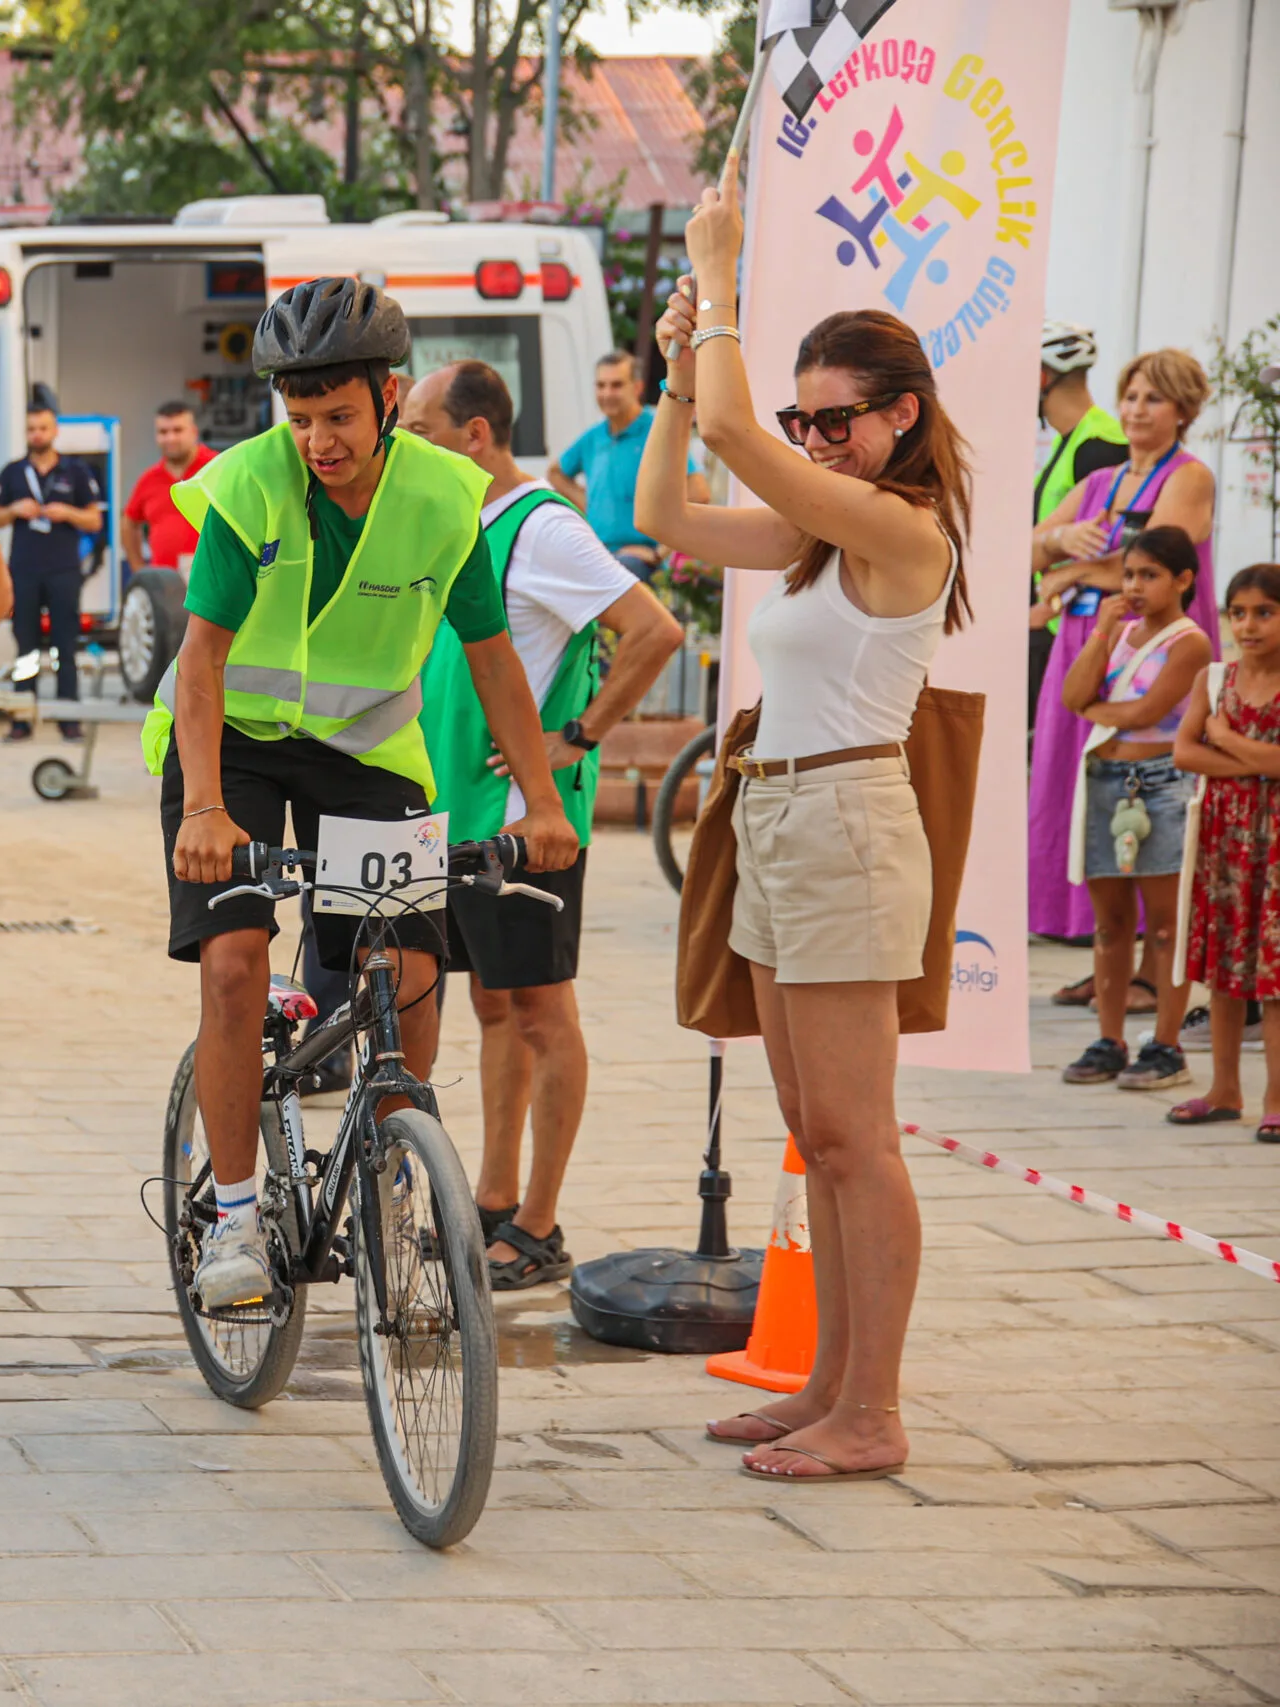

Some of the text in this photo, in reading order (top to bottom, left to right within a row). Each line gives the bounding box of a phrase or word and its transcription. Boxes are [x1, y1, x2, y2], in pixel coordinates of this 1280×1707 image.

[920, 255, 1017, 369] Günler
[361, 851, 413, 890] 03
[951, 960, 999, 992] bilgi
[283, 1121, 300, 1178] SALCANO
[328, 1163, 341, 1198] SALCANO
